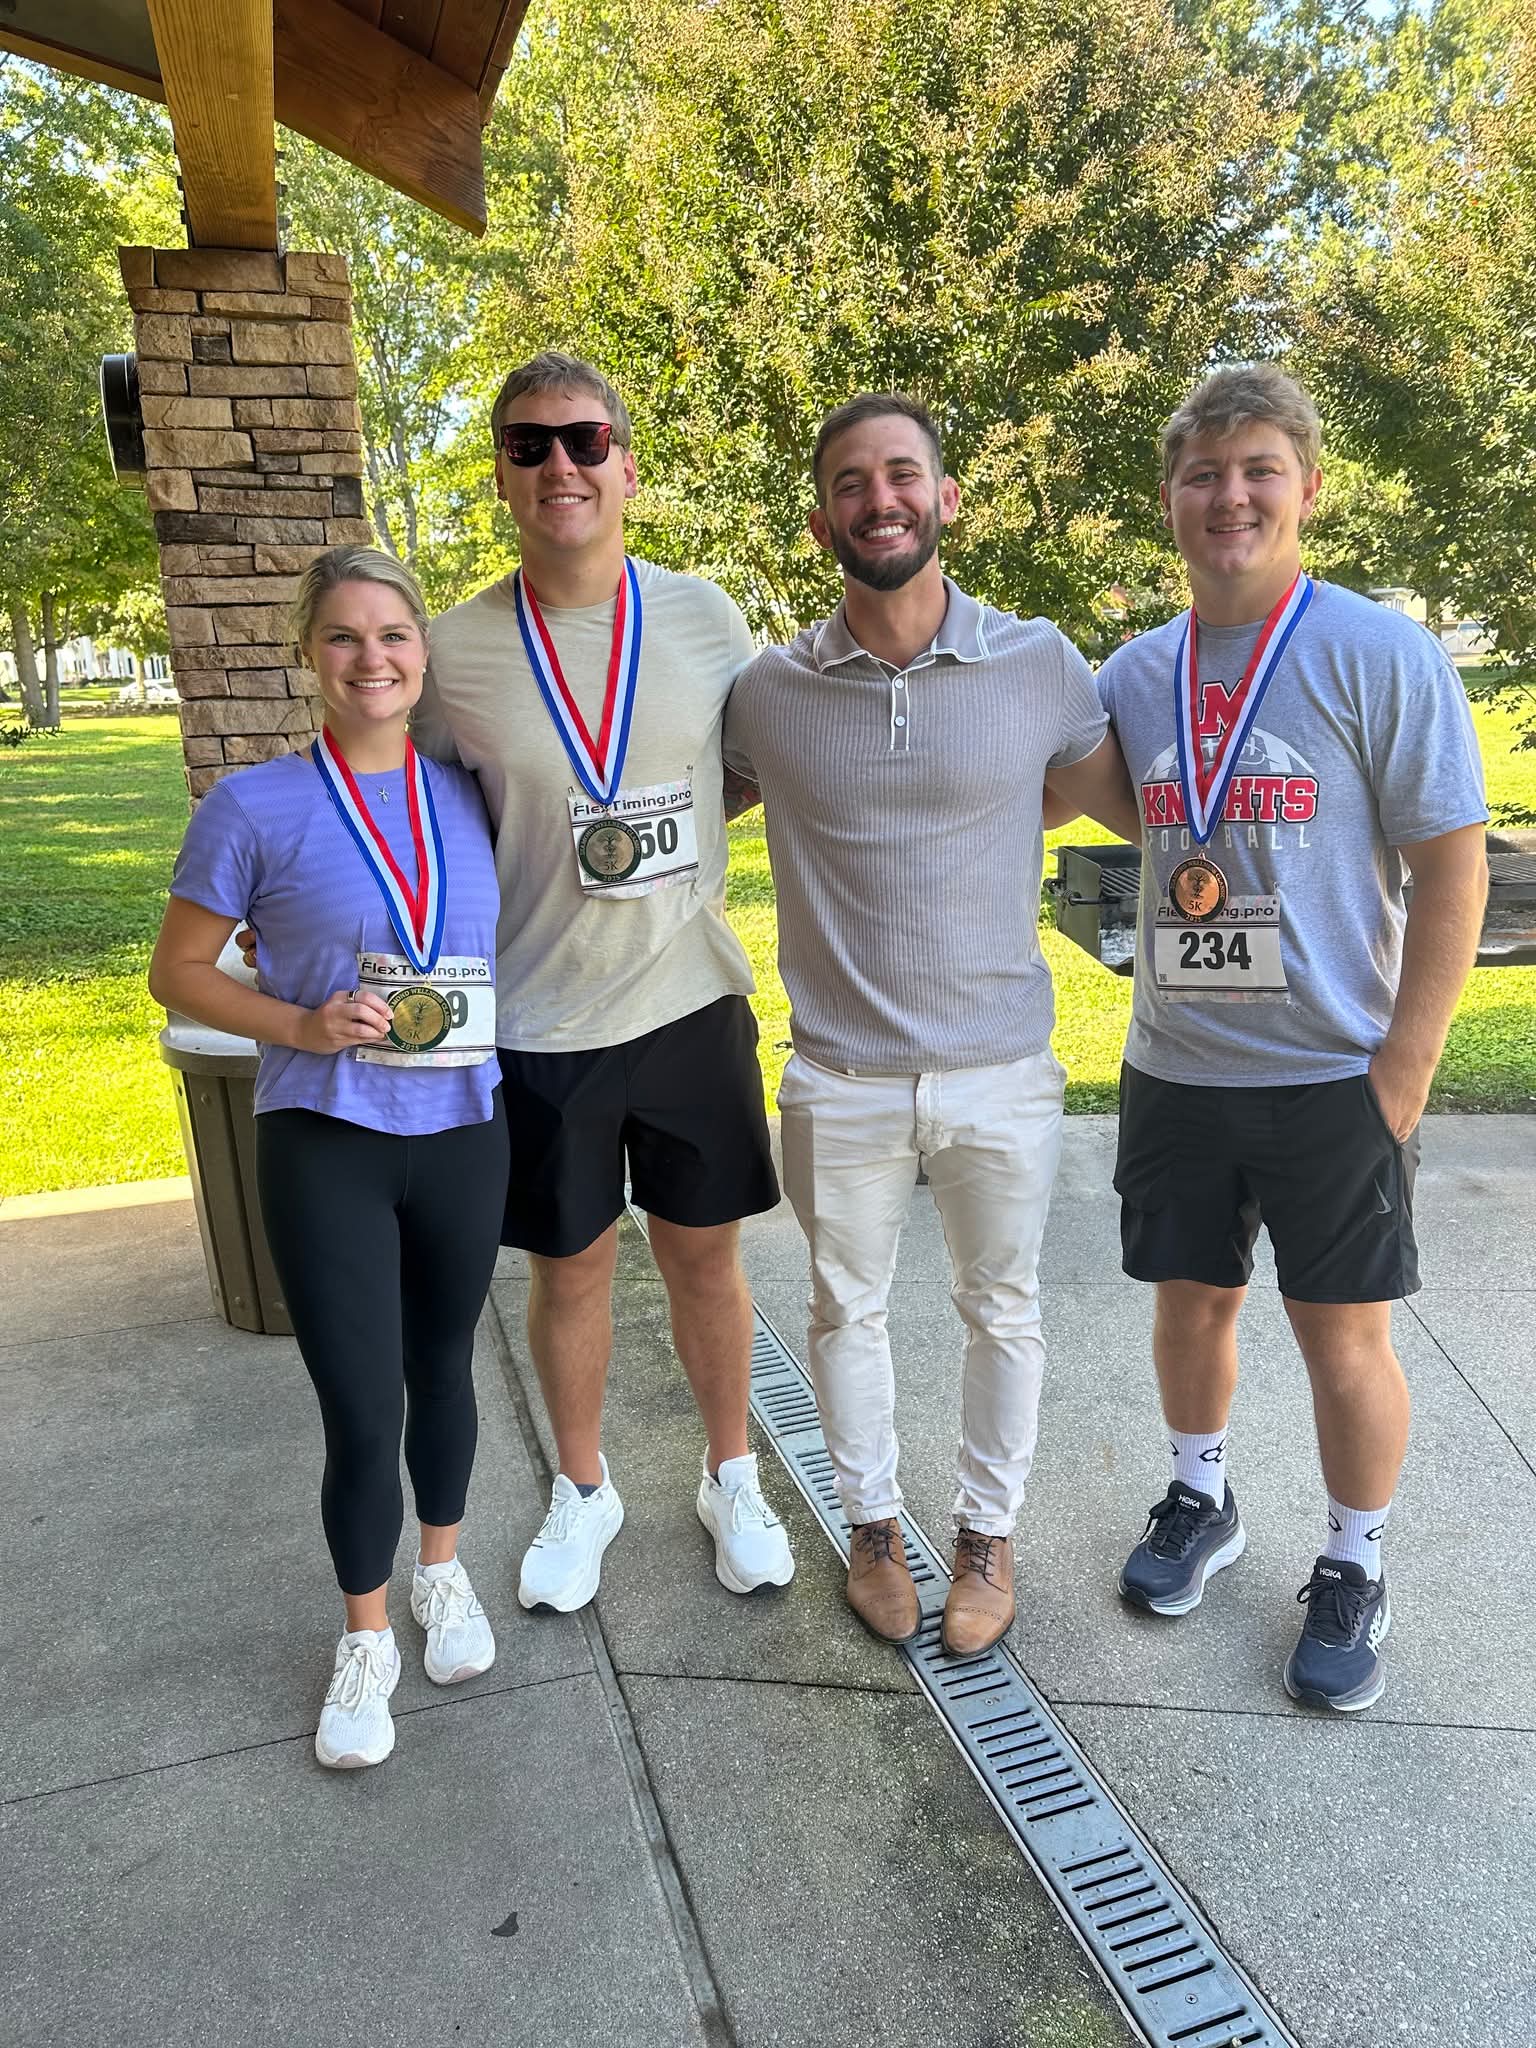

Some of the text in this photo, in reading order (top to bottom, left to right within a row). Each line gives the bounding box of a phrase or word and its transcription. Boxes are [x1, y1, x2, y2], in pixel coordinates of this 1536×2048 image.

[1199, 678, 1246, 738] M
[1141, 774, 1319, 827] KNHTS
[1158, 906, 1274, 919] Fleng.pro
[1188, 900, 1203, 911] 5K
[1179, 932, 1252, 969] 234
[361, 961, 487, 978] FlexTiing.pro
[407, 1029, 420, 1040] 5K
[1179, 1494, 1200, 1509] HOKA
[1320, 1567, 1341, 1580] HOKA
